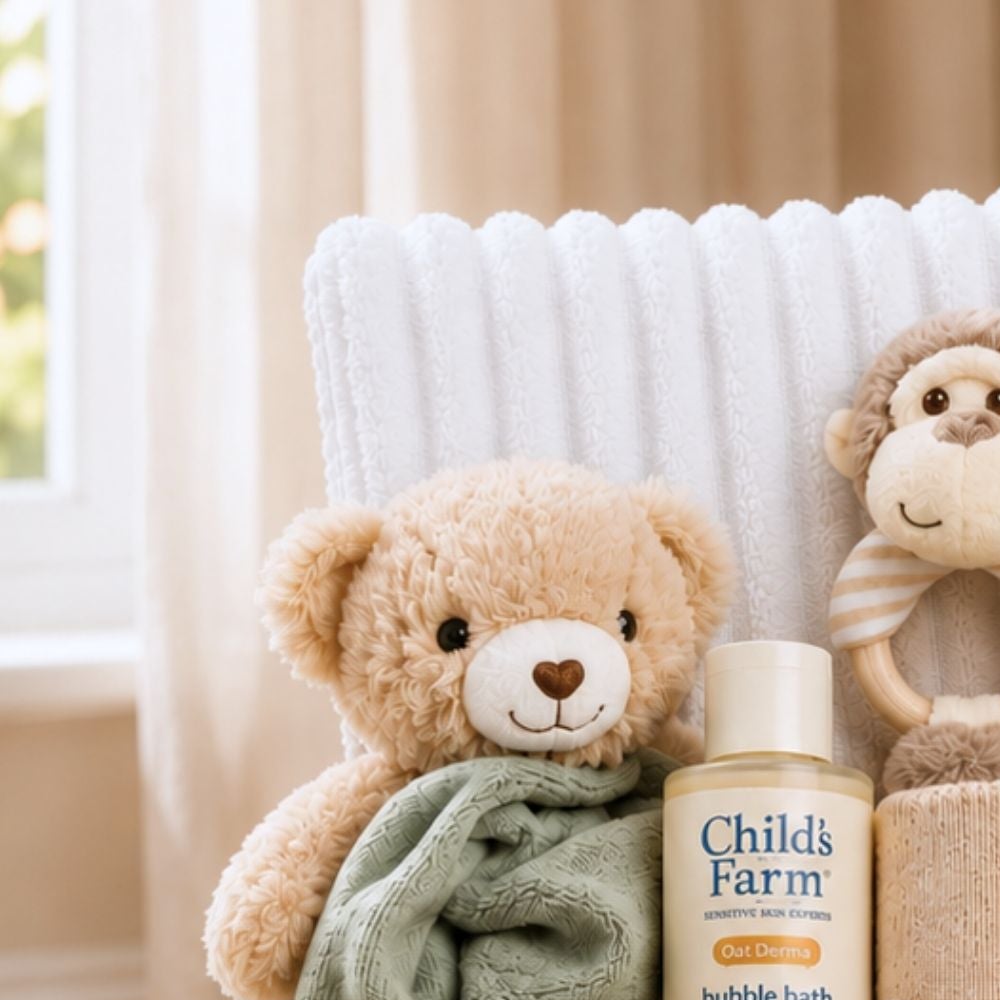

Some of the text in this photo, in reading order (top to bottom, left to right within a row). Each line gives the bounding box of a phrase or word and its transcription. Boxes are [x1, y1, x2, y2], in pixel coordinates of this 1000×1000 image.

[701, 813, 833, 857] Child's
[710, 859, 823, 897] Farm
[721, 943, 811, 959] Oat Derma
